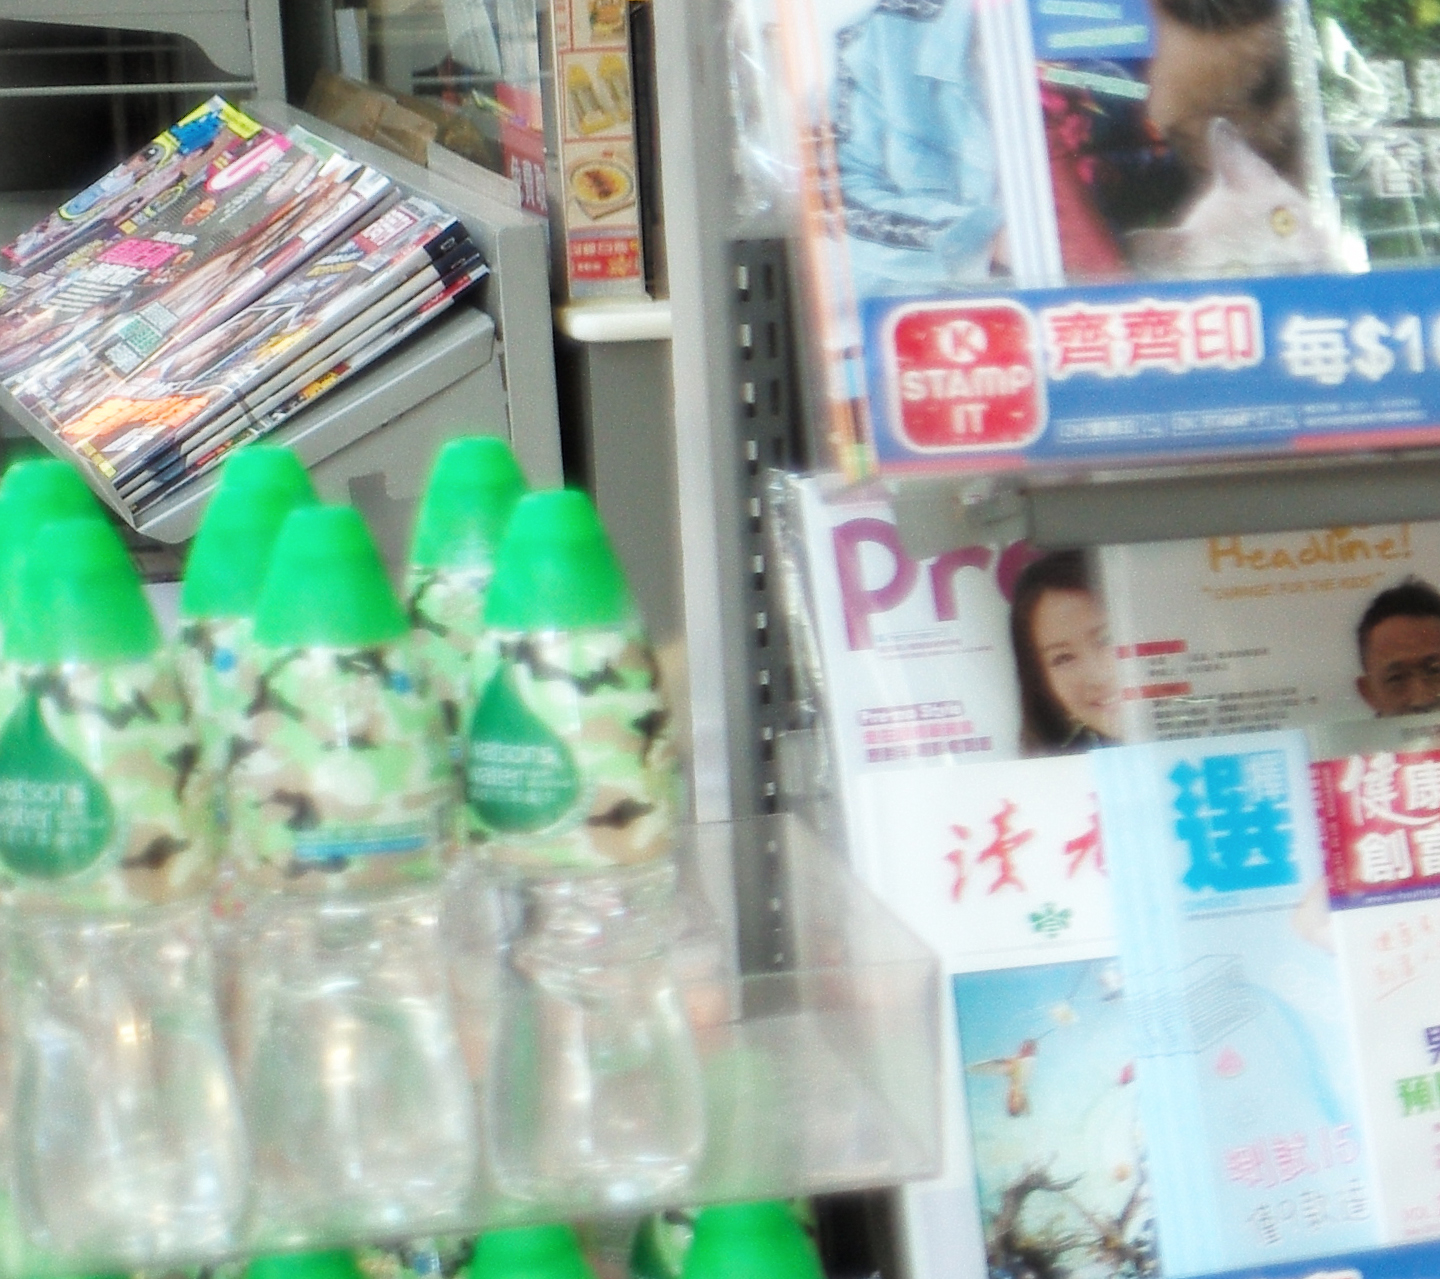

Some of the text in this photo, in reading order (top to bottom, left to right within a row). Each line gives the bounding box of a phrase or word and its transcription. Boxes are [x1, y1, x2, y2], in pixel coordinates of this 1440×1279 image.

[1046, 300, 1258, 377] 齊齊印
[901, 364, 1032, 401] STAMP
[948, 404, 985, 434] IT
